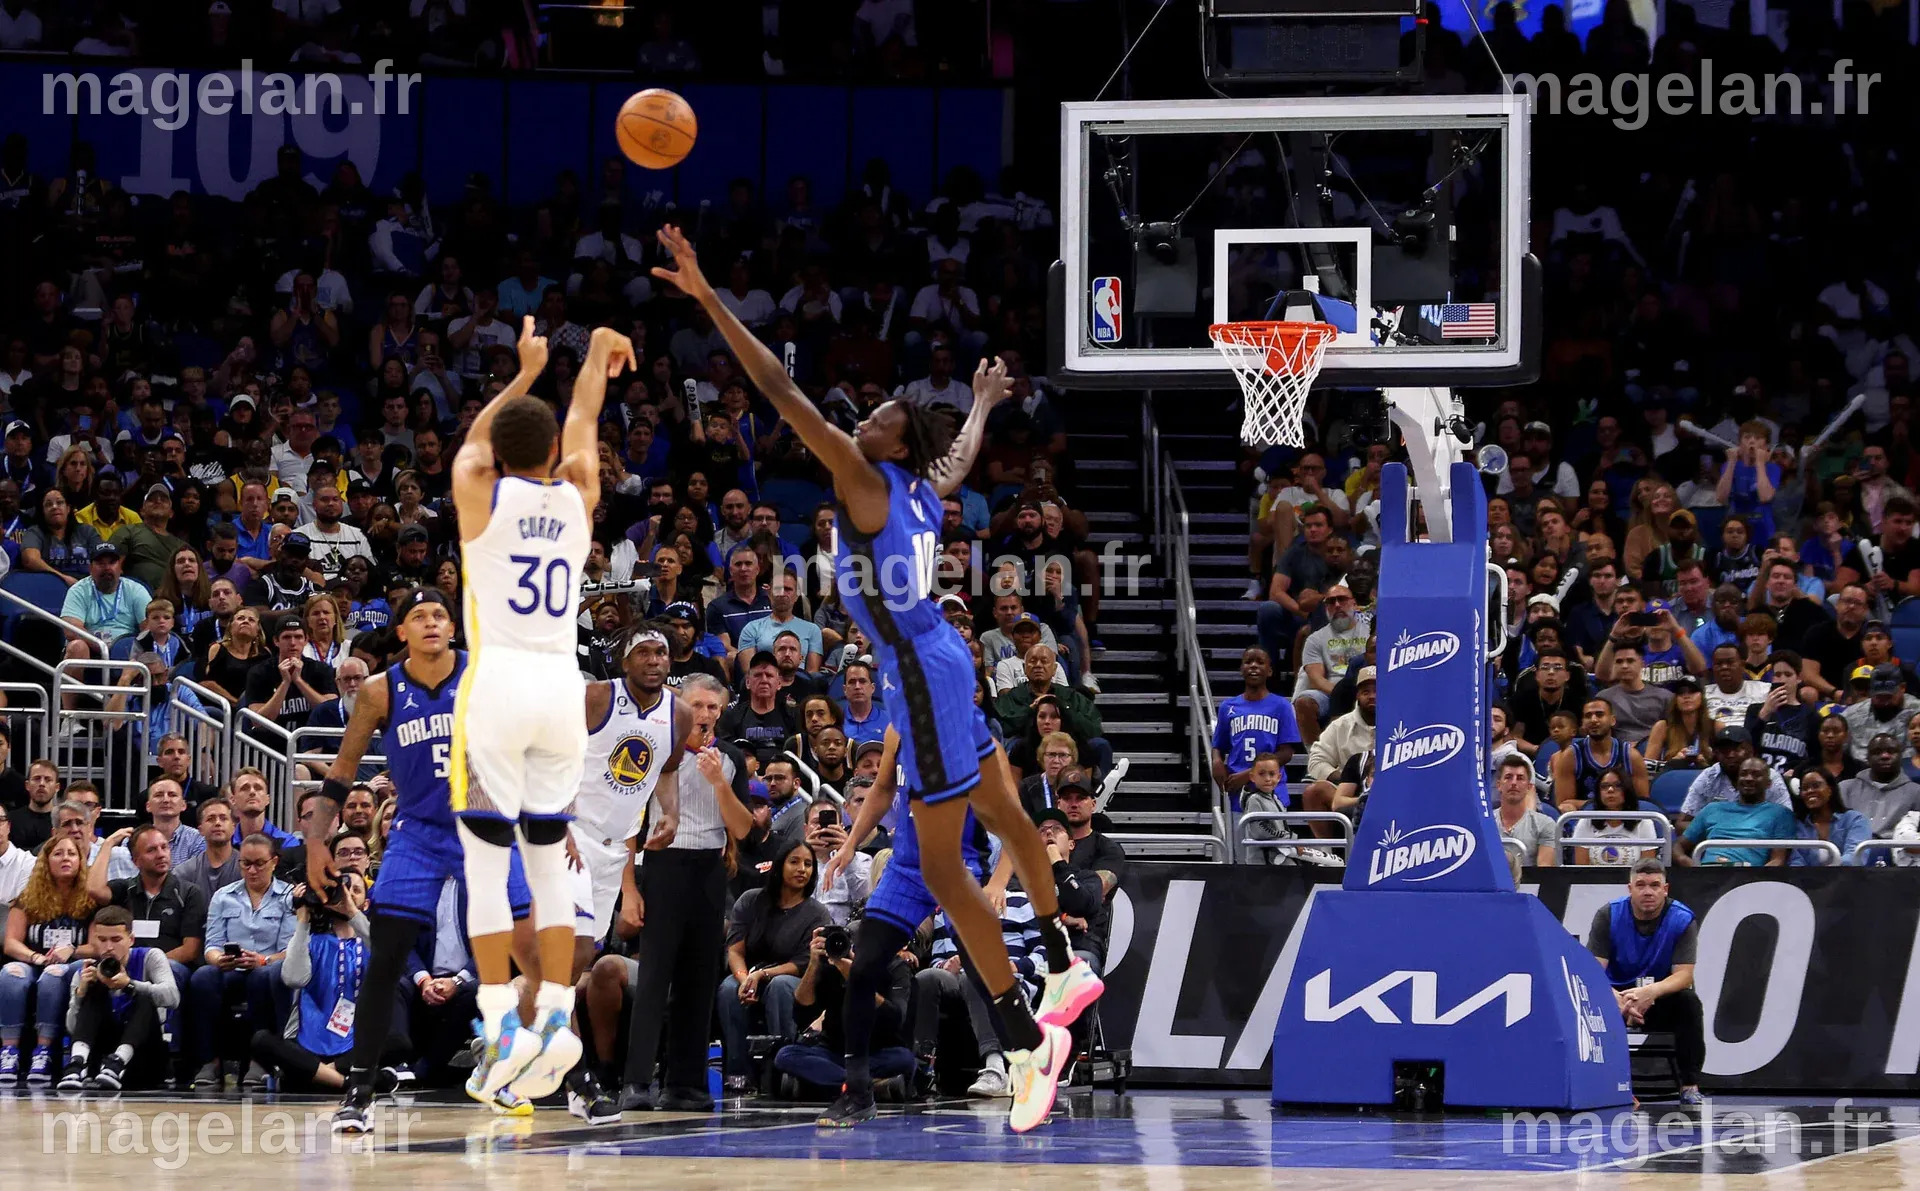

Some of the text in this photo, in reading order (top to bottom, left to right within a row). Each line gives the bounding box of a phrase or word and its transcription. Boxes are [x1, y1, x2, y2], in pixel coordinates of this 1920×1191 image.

[1097, 327, 1111, 338] NBA
[518, 515, 566, 542] CURRY
[508, 554, 570, 617] 30
[1388, 637, 1453, 672] LIBMAN
[396, 682, 406, 693] 6
[616, 728, 643, 742] GOLDEN
[745, 725, 785, 739] MAGIC
[1230, 714, 1279, 737] ORLANDO
[431, 743, 450, 779] 5
[637, 751, 648, 765] 5
[1244, 737, 1256, 762] 5
[1381, 732, 1458, 772] LIBMAN
[603, 770, 648, 796] WARRIORS
[1368, 834, 1465, 886] LIBMAN
